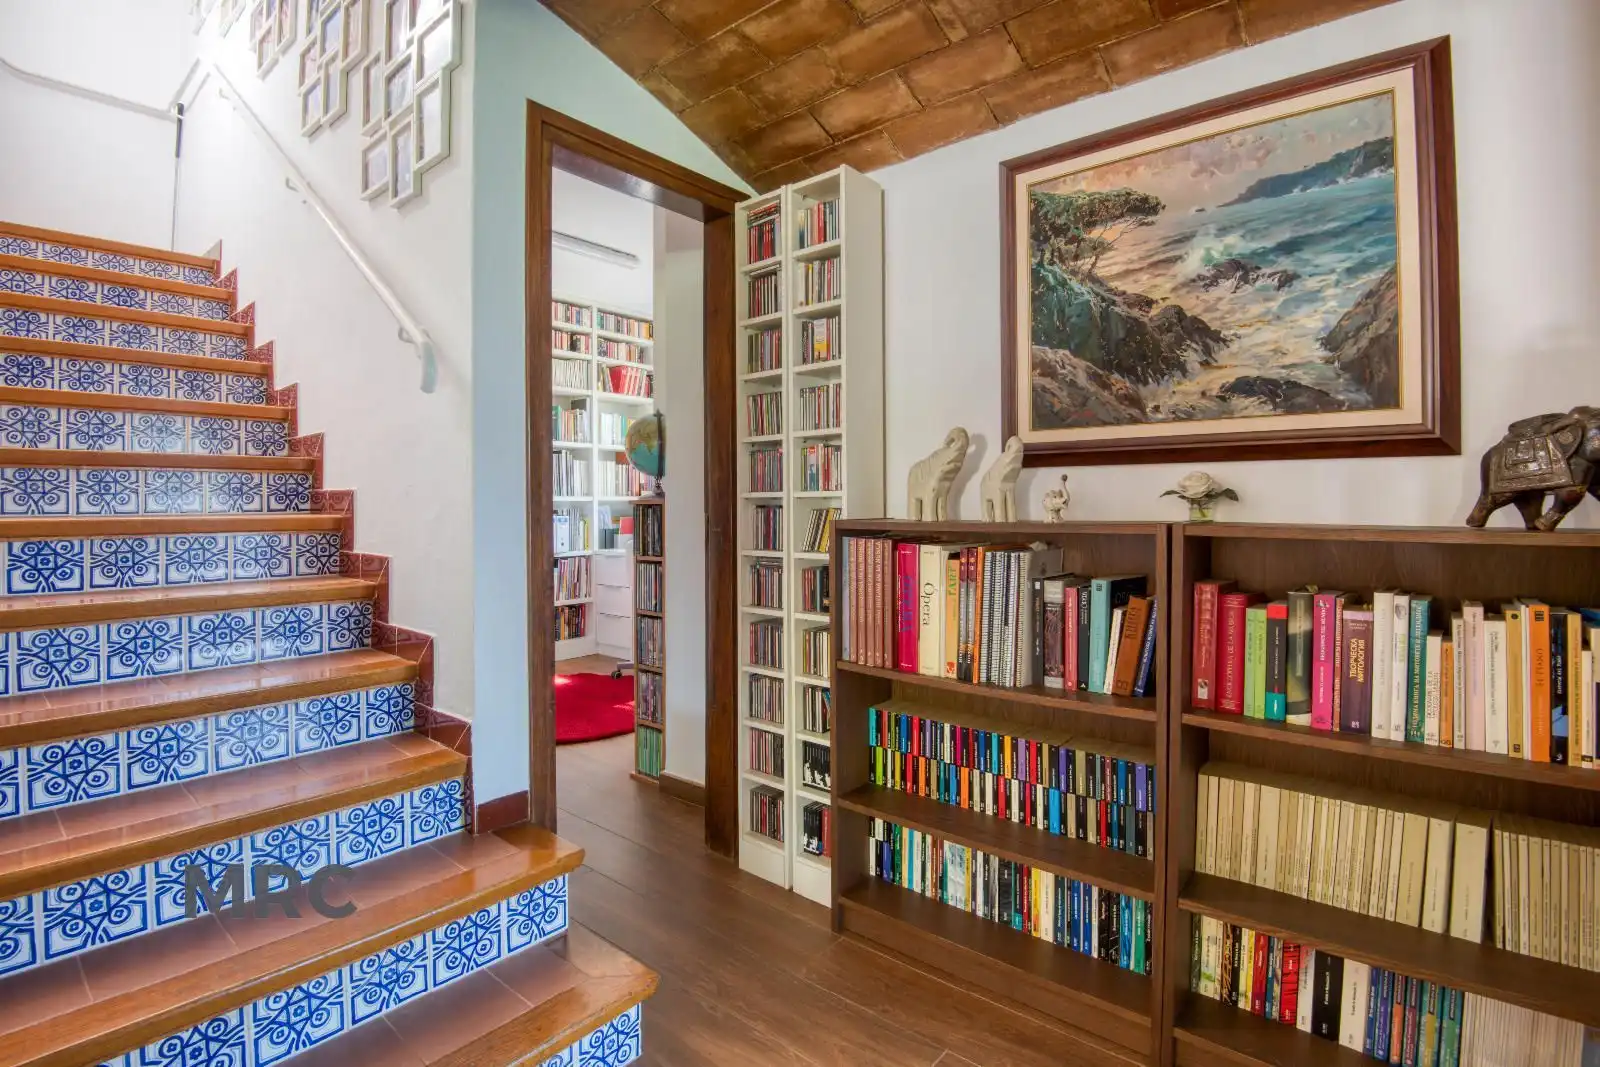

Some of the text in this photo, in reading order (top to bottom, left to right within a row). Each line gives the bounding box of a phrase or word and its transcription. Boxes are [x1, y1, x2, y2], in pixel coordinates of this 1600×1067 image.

[921, 582, 938, 625] Ópera
[1349, 638, 1358, 677] ТВОРЧЕСКА
[1357, 639, 1365, 683] МИТОЛОГИЯ
